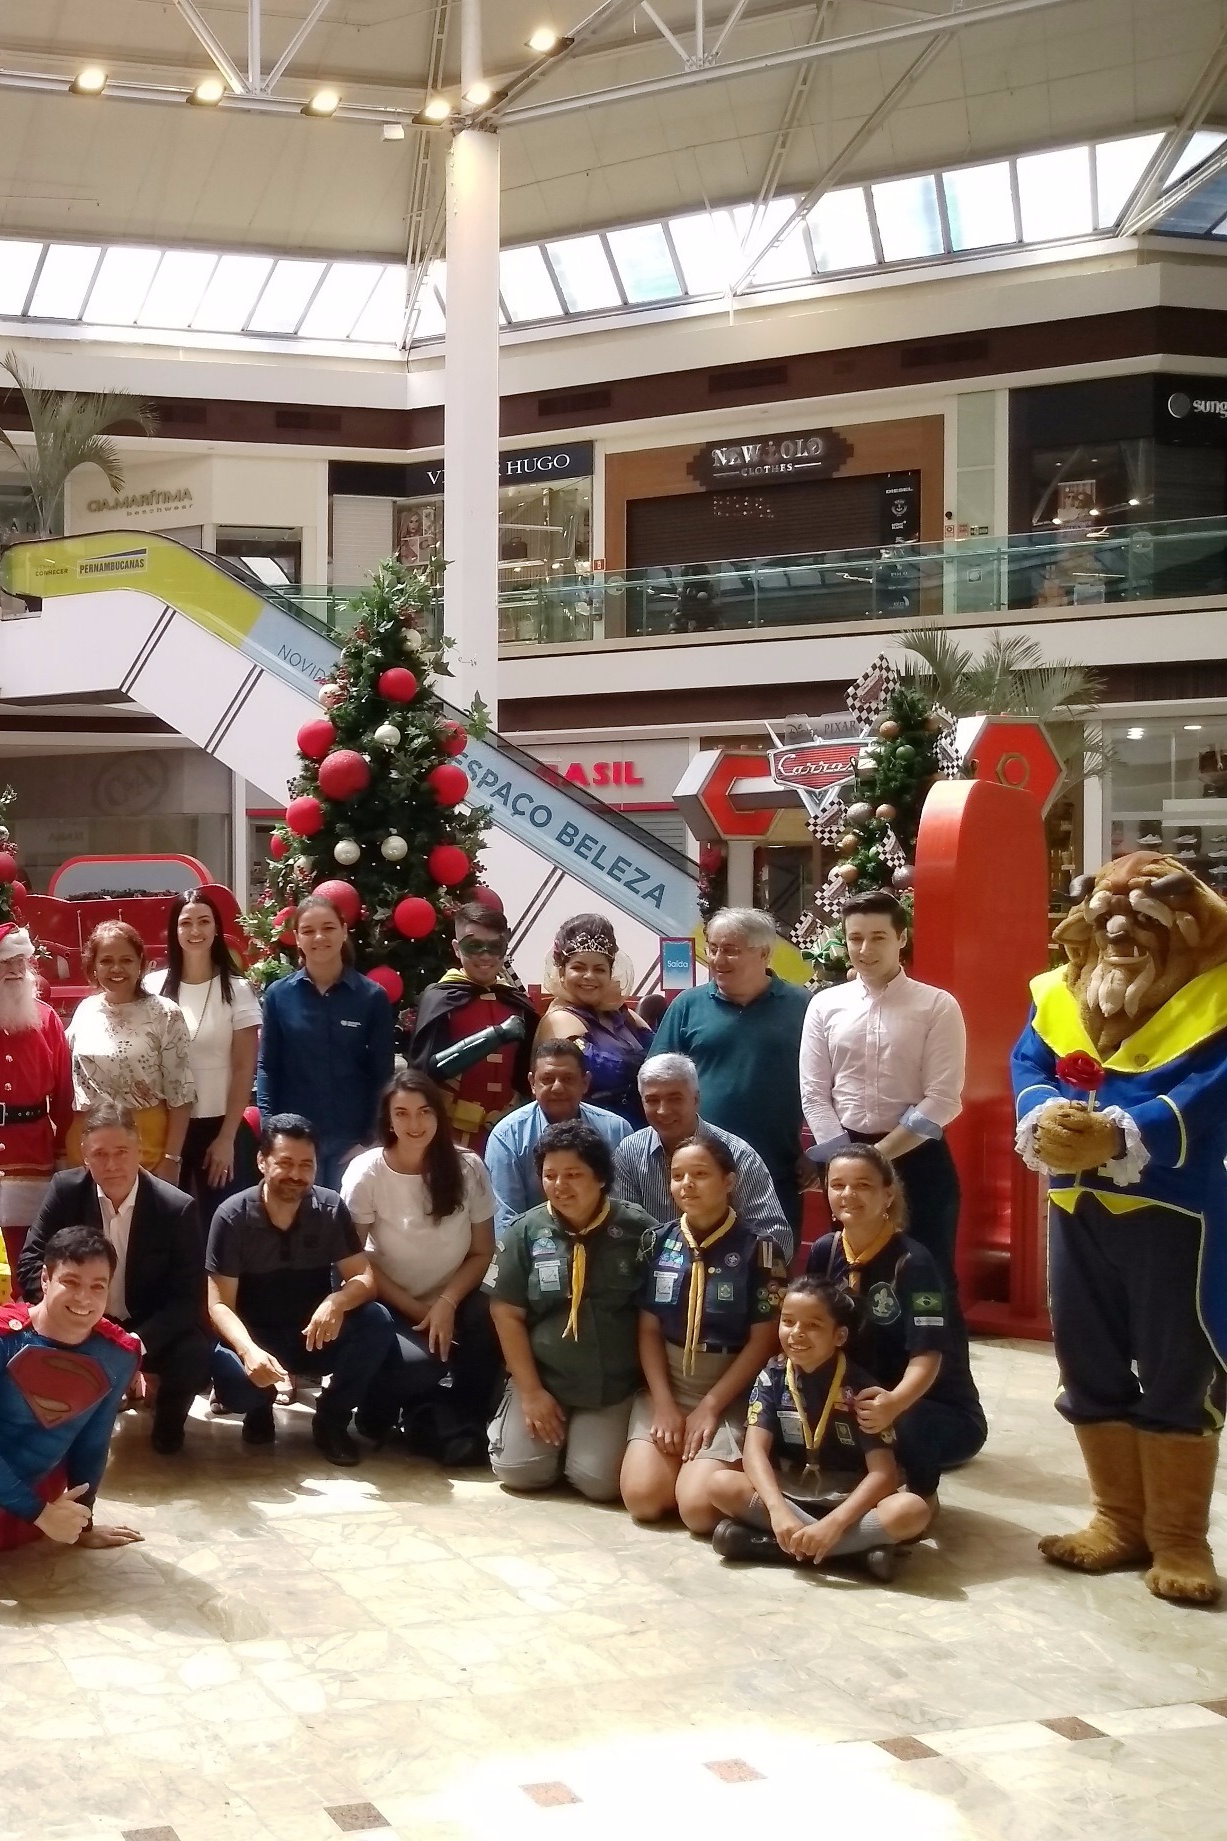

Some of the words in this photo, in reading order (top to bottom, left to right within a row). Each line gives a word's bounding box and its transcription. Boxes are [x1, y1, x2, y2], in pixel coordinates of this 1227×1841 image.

[506, 453, 570, 475] HUGO
[79, 558, 145, 575] PERNAMBUCANAS
[824, 720, 857, 735] PIXAR
[555, 820, 667, 911] BELEZA
